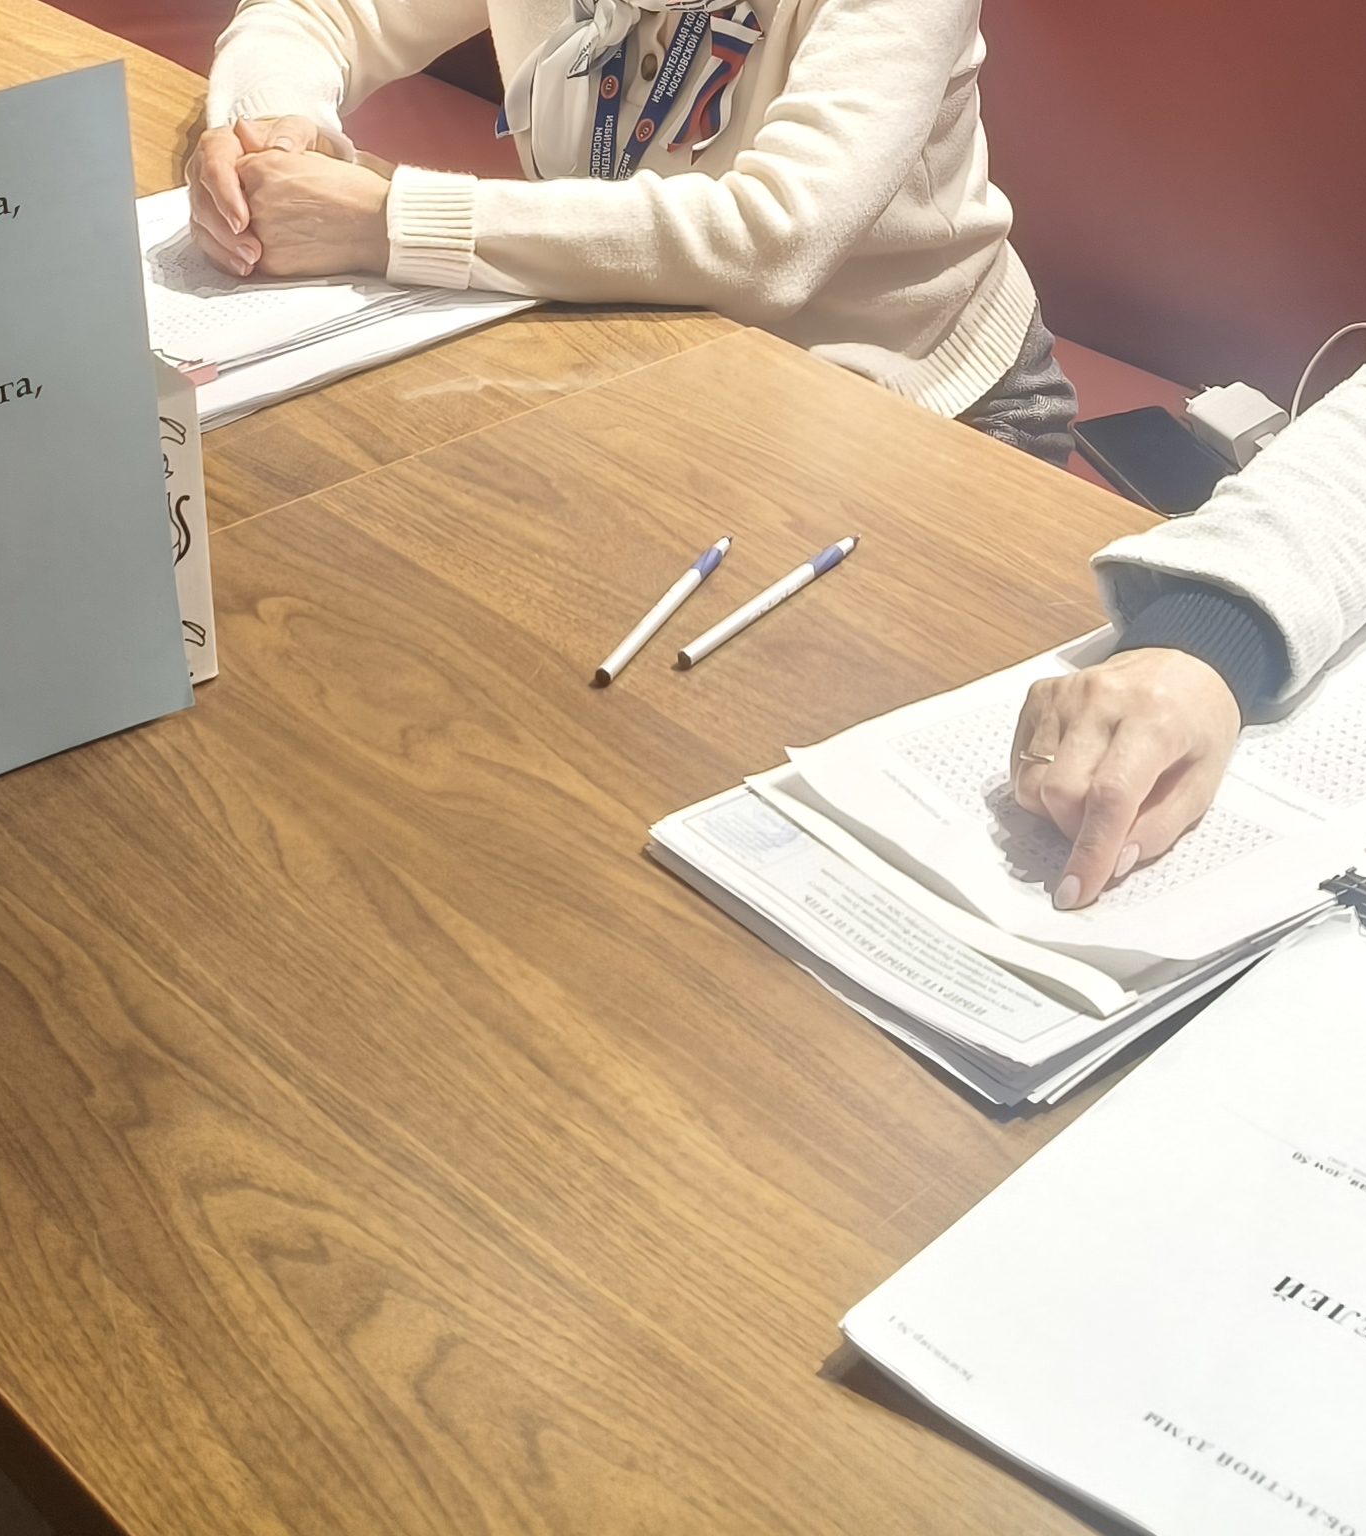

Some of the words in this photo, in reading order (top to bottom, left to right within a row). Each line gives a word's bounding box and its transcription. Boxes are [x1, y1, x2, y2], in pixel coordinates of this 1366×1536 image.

[651, 33, 688, 104] ИЗБИРАТЕЛЬНАЯ
[665, 33, 699, 98] МОСКОВСКОЙ
[1143, 1411, 1207, 1452] ДУМЫ
[1216, 1451, 1356, 1536] ОБЛАСТНОЙ
